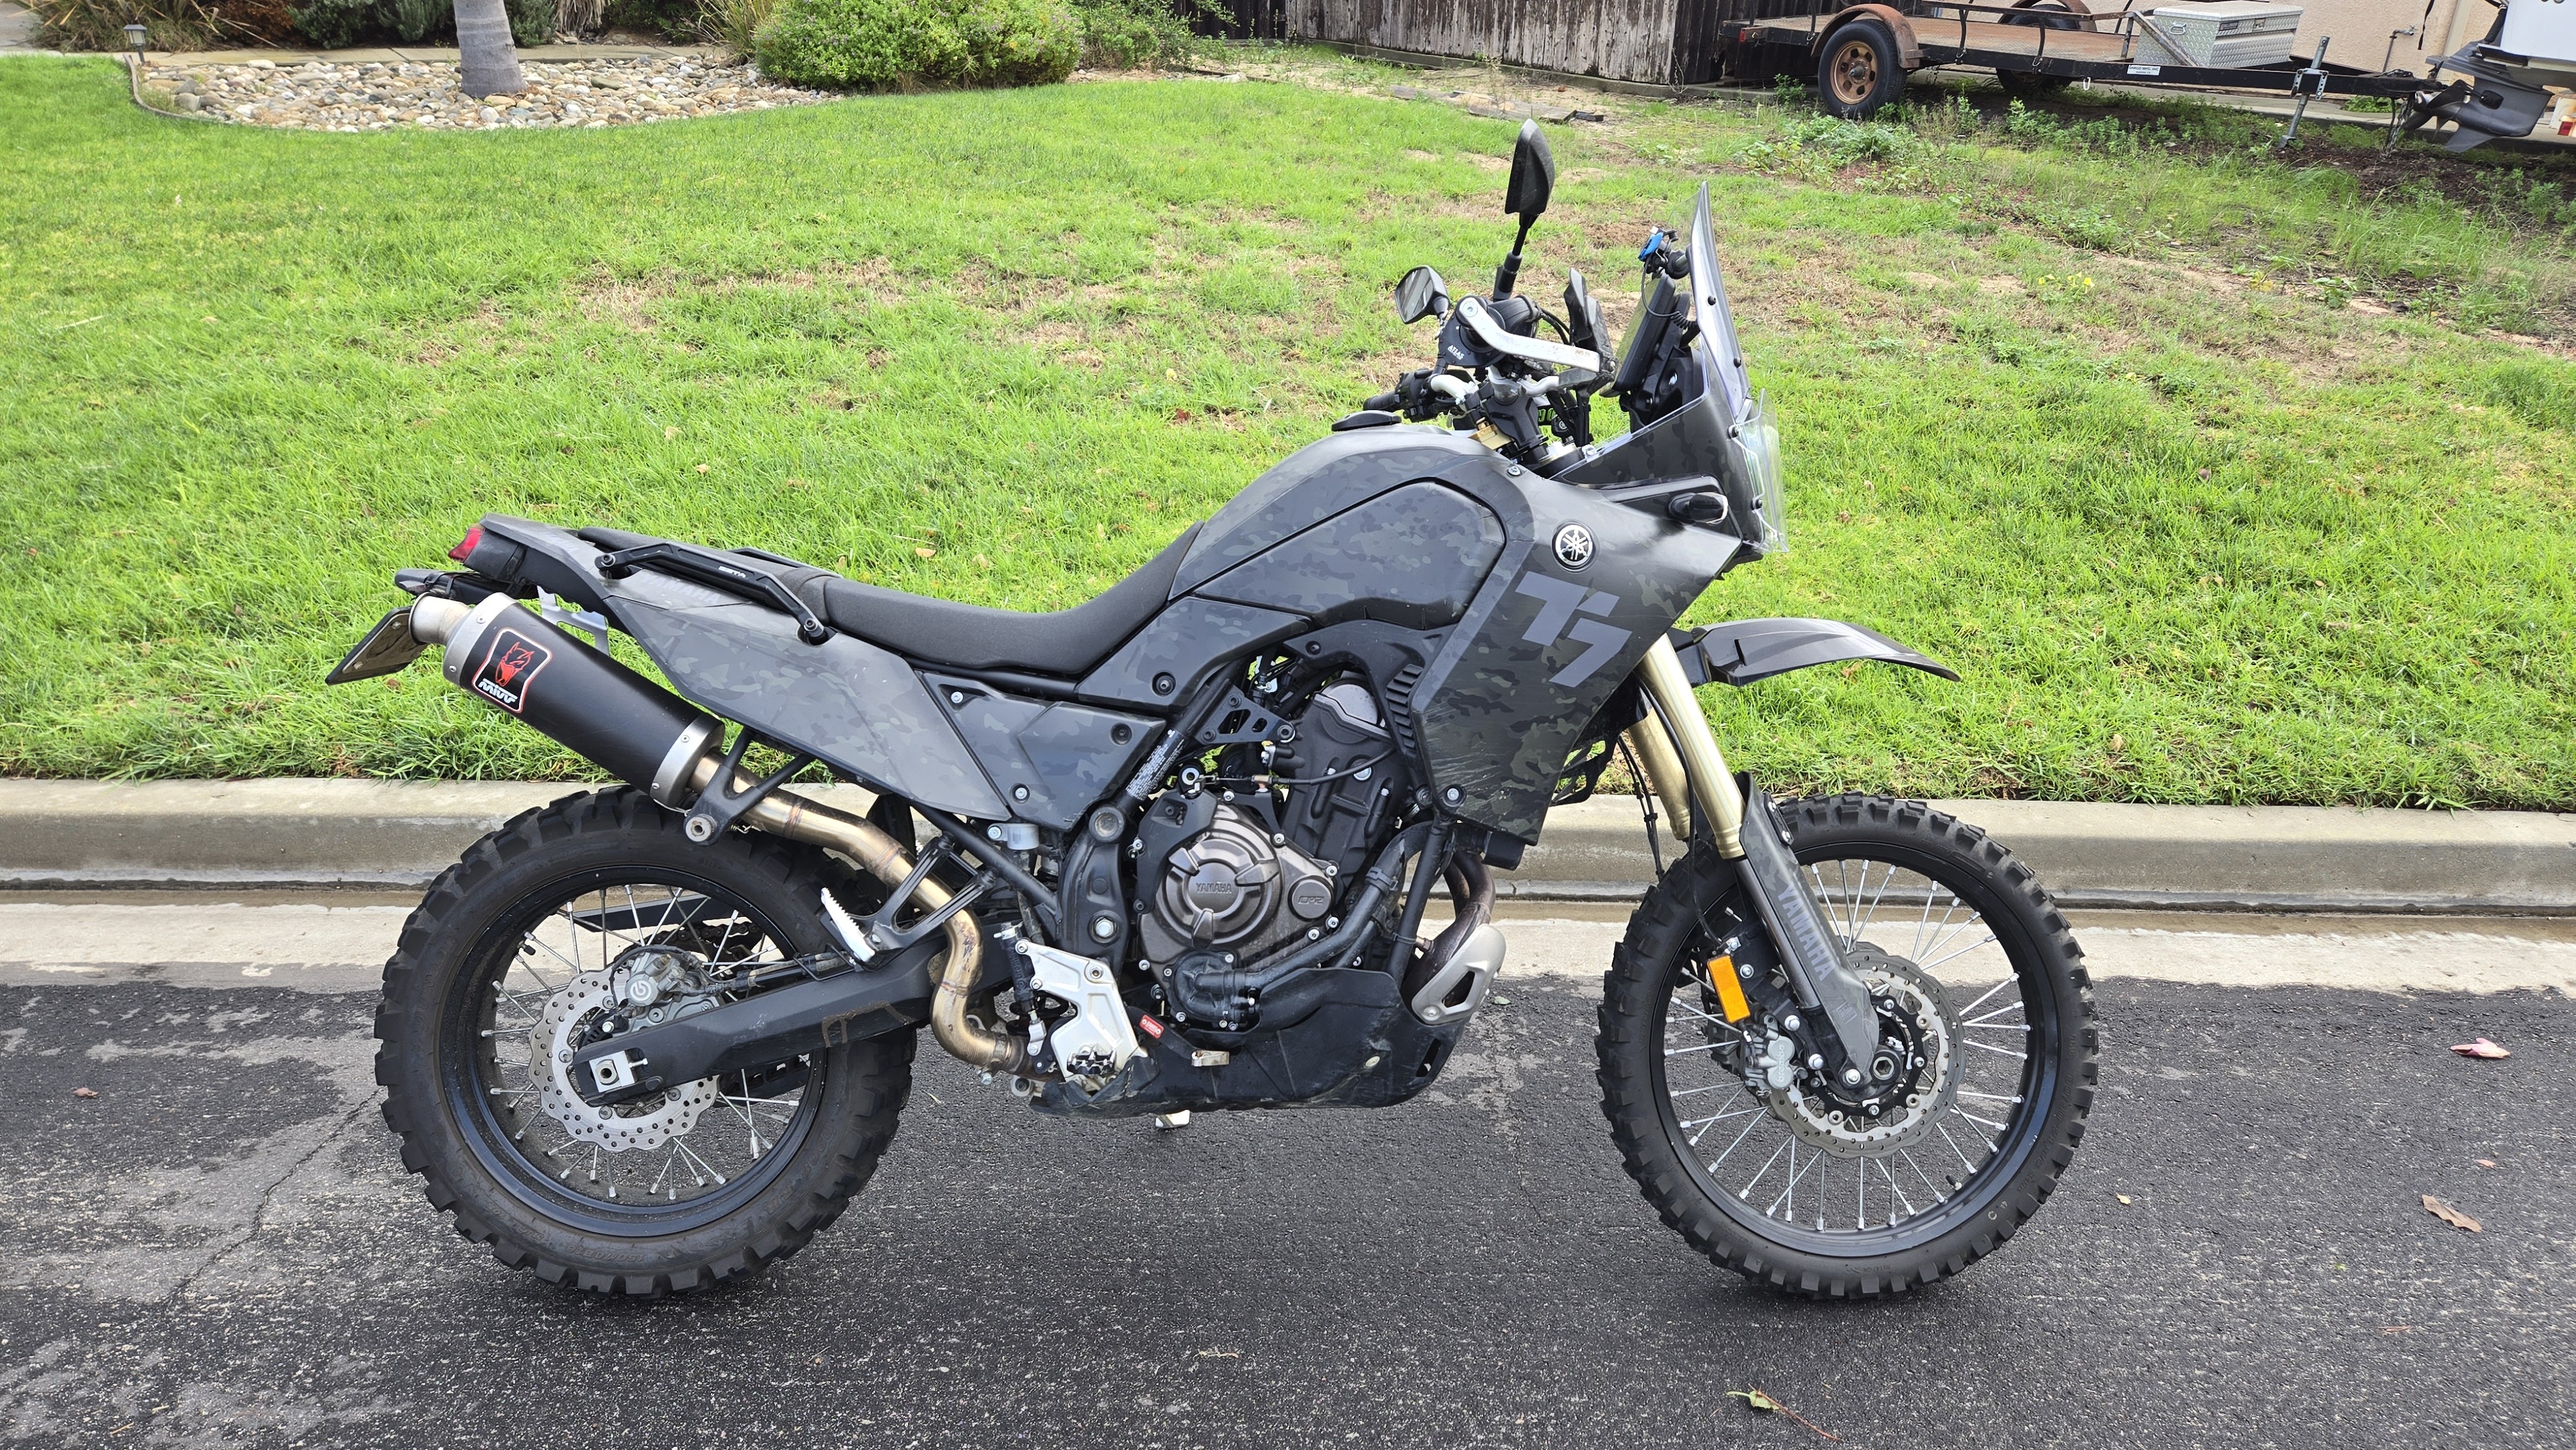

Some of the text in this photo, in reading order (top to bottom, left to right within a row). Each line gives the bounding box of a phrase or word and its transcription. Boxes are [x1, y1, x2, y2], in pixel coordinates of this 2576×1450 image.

[1448, 345, 1464, 358] ATLAS
[644, 572, 721, 604] YAMAHA
[1196, 882, 1232, 894] YAMAHA
[1778, 881, 1835, 981] YAMAHA
[1776, 1044, 1785, 1082] brembo
